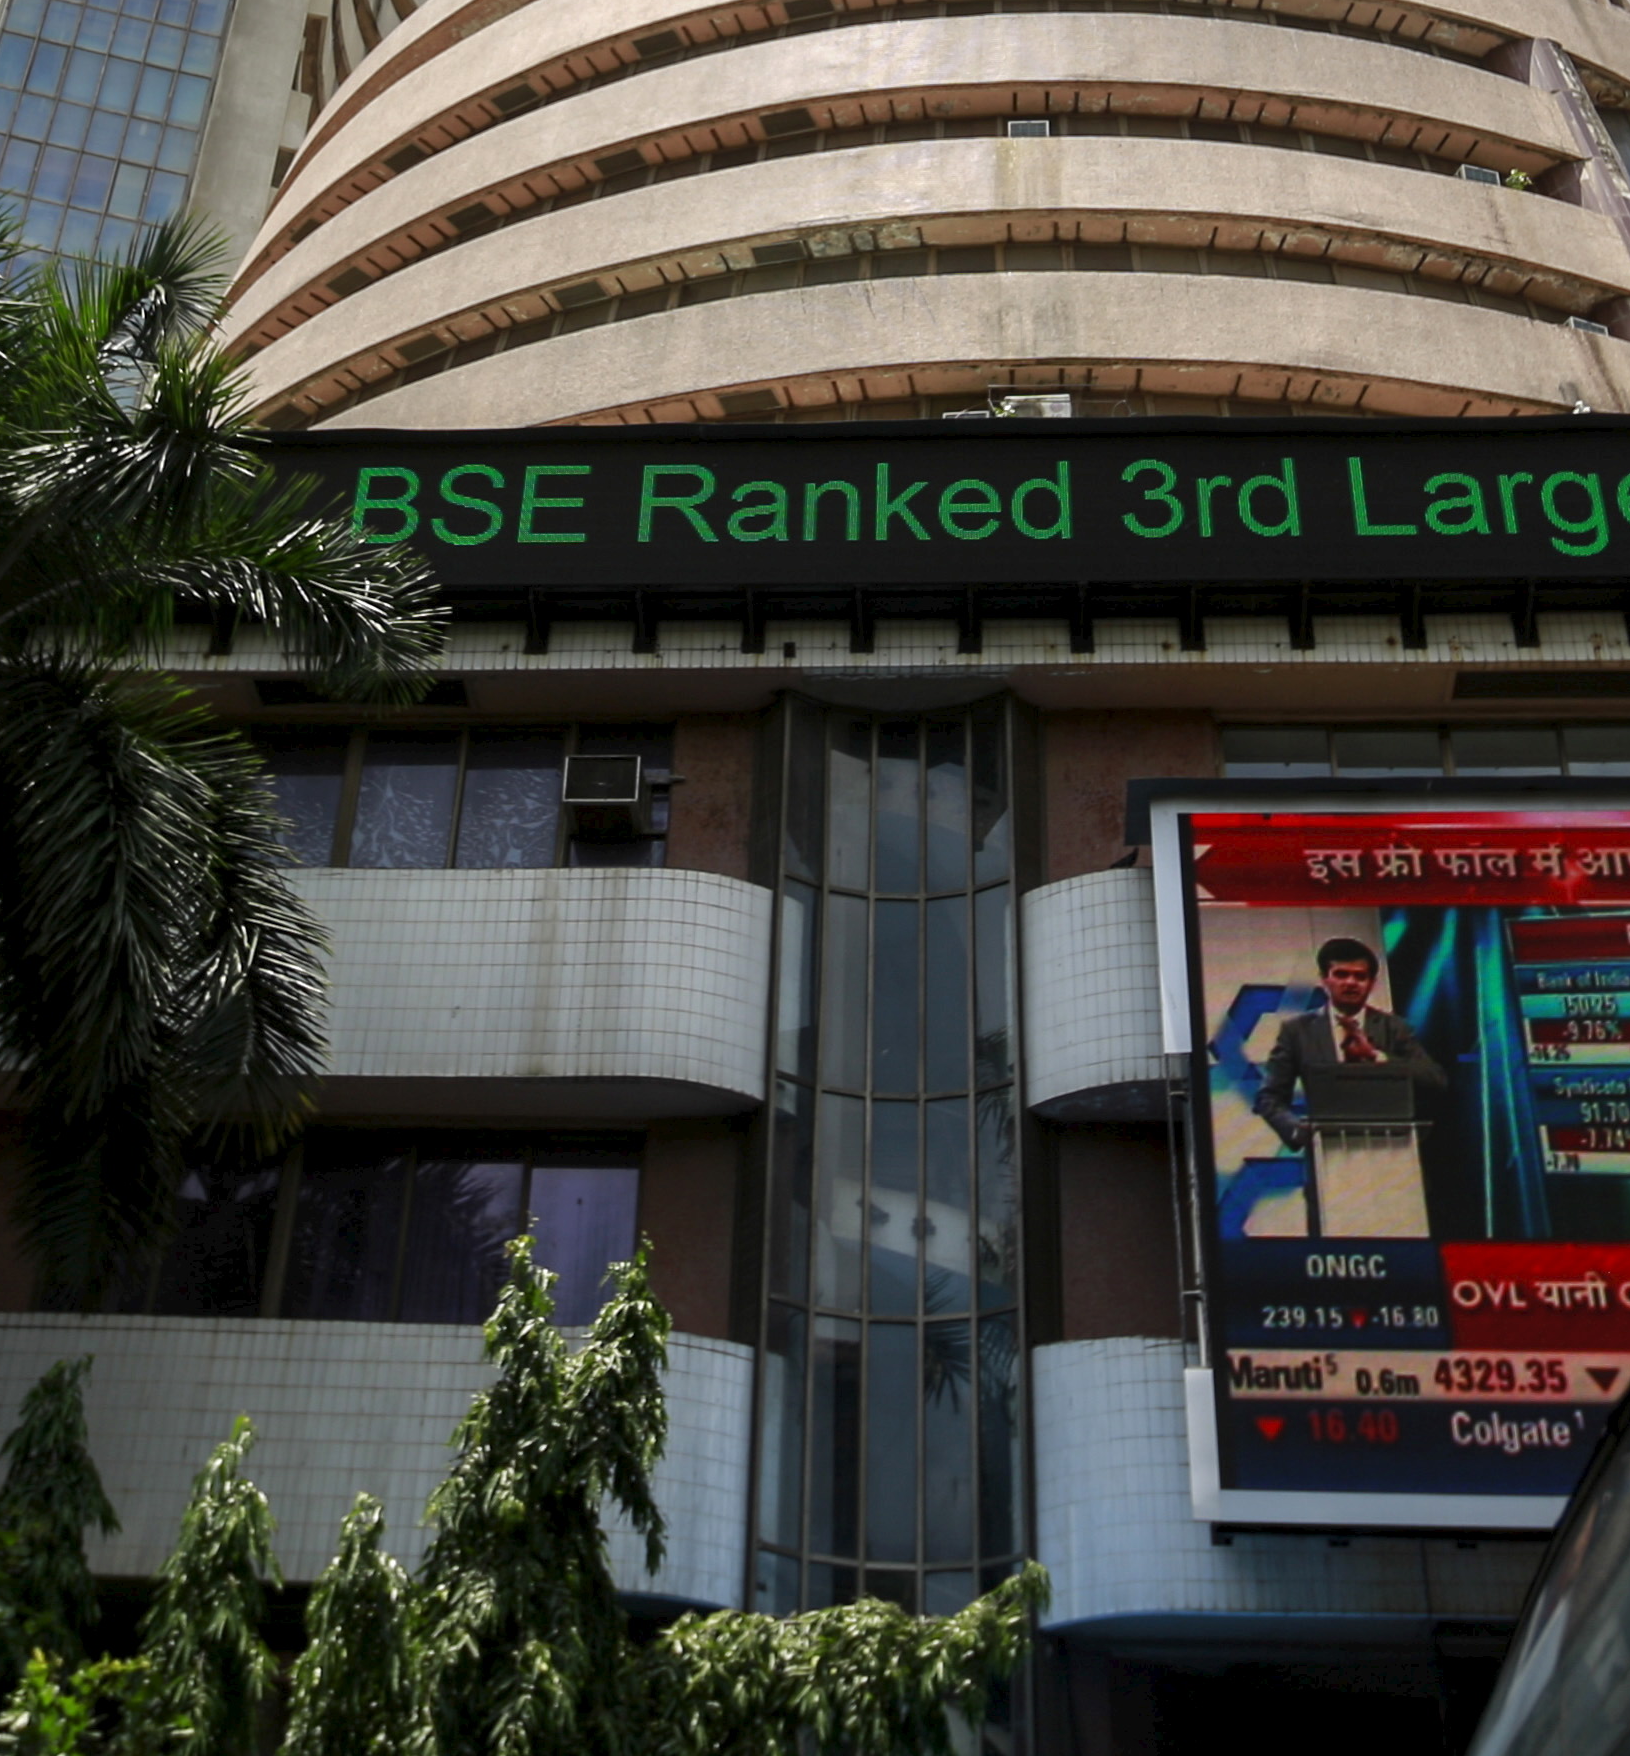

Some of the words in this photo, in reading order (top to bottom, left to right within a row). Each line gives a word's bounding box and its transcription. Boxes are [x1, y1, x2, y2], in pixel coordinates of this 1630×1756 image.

[349, 464, 592, 546] BSE
[638, 461, 1073, 543] Ranked
[1121, 458, 1301, 539] 3rd
[1303, 848, 1362, 883] इस
[1579, 1101, 1630, 1124] 91.70
[1306, 1254, 1386, 1279] ONGC
[1452, 1280, 1527, 1308] OVL
[1536, 1271, 1607, 1309] यानी
[1262, 1306, 1343, 1328] 239.15
[1372, 1306, 1439, 1328] -16.80
[1355, 1368, 1420, 1397] 0.6m
[1434, 1357, 1568, 1394] 4329.35
[1309, 1409, 1400, 1443] 16.40
[1451, 1410, 1571, 1454] Colgate
